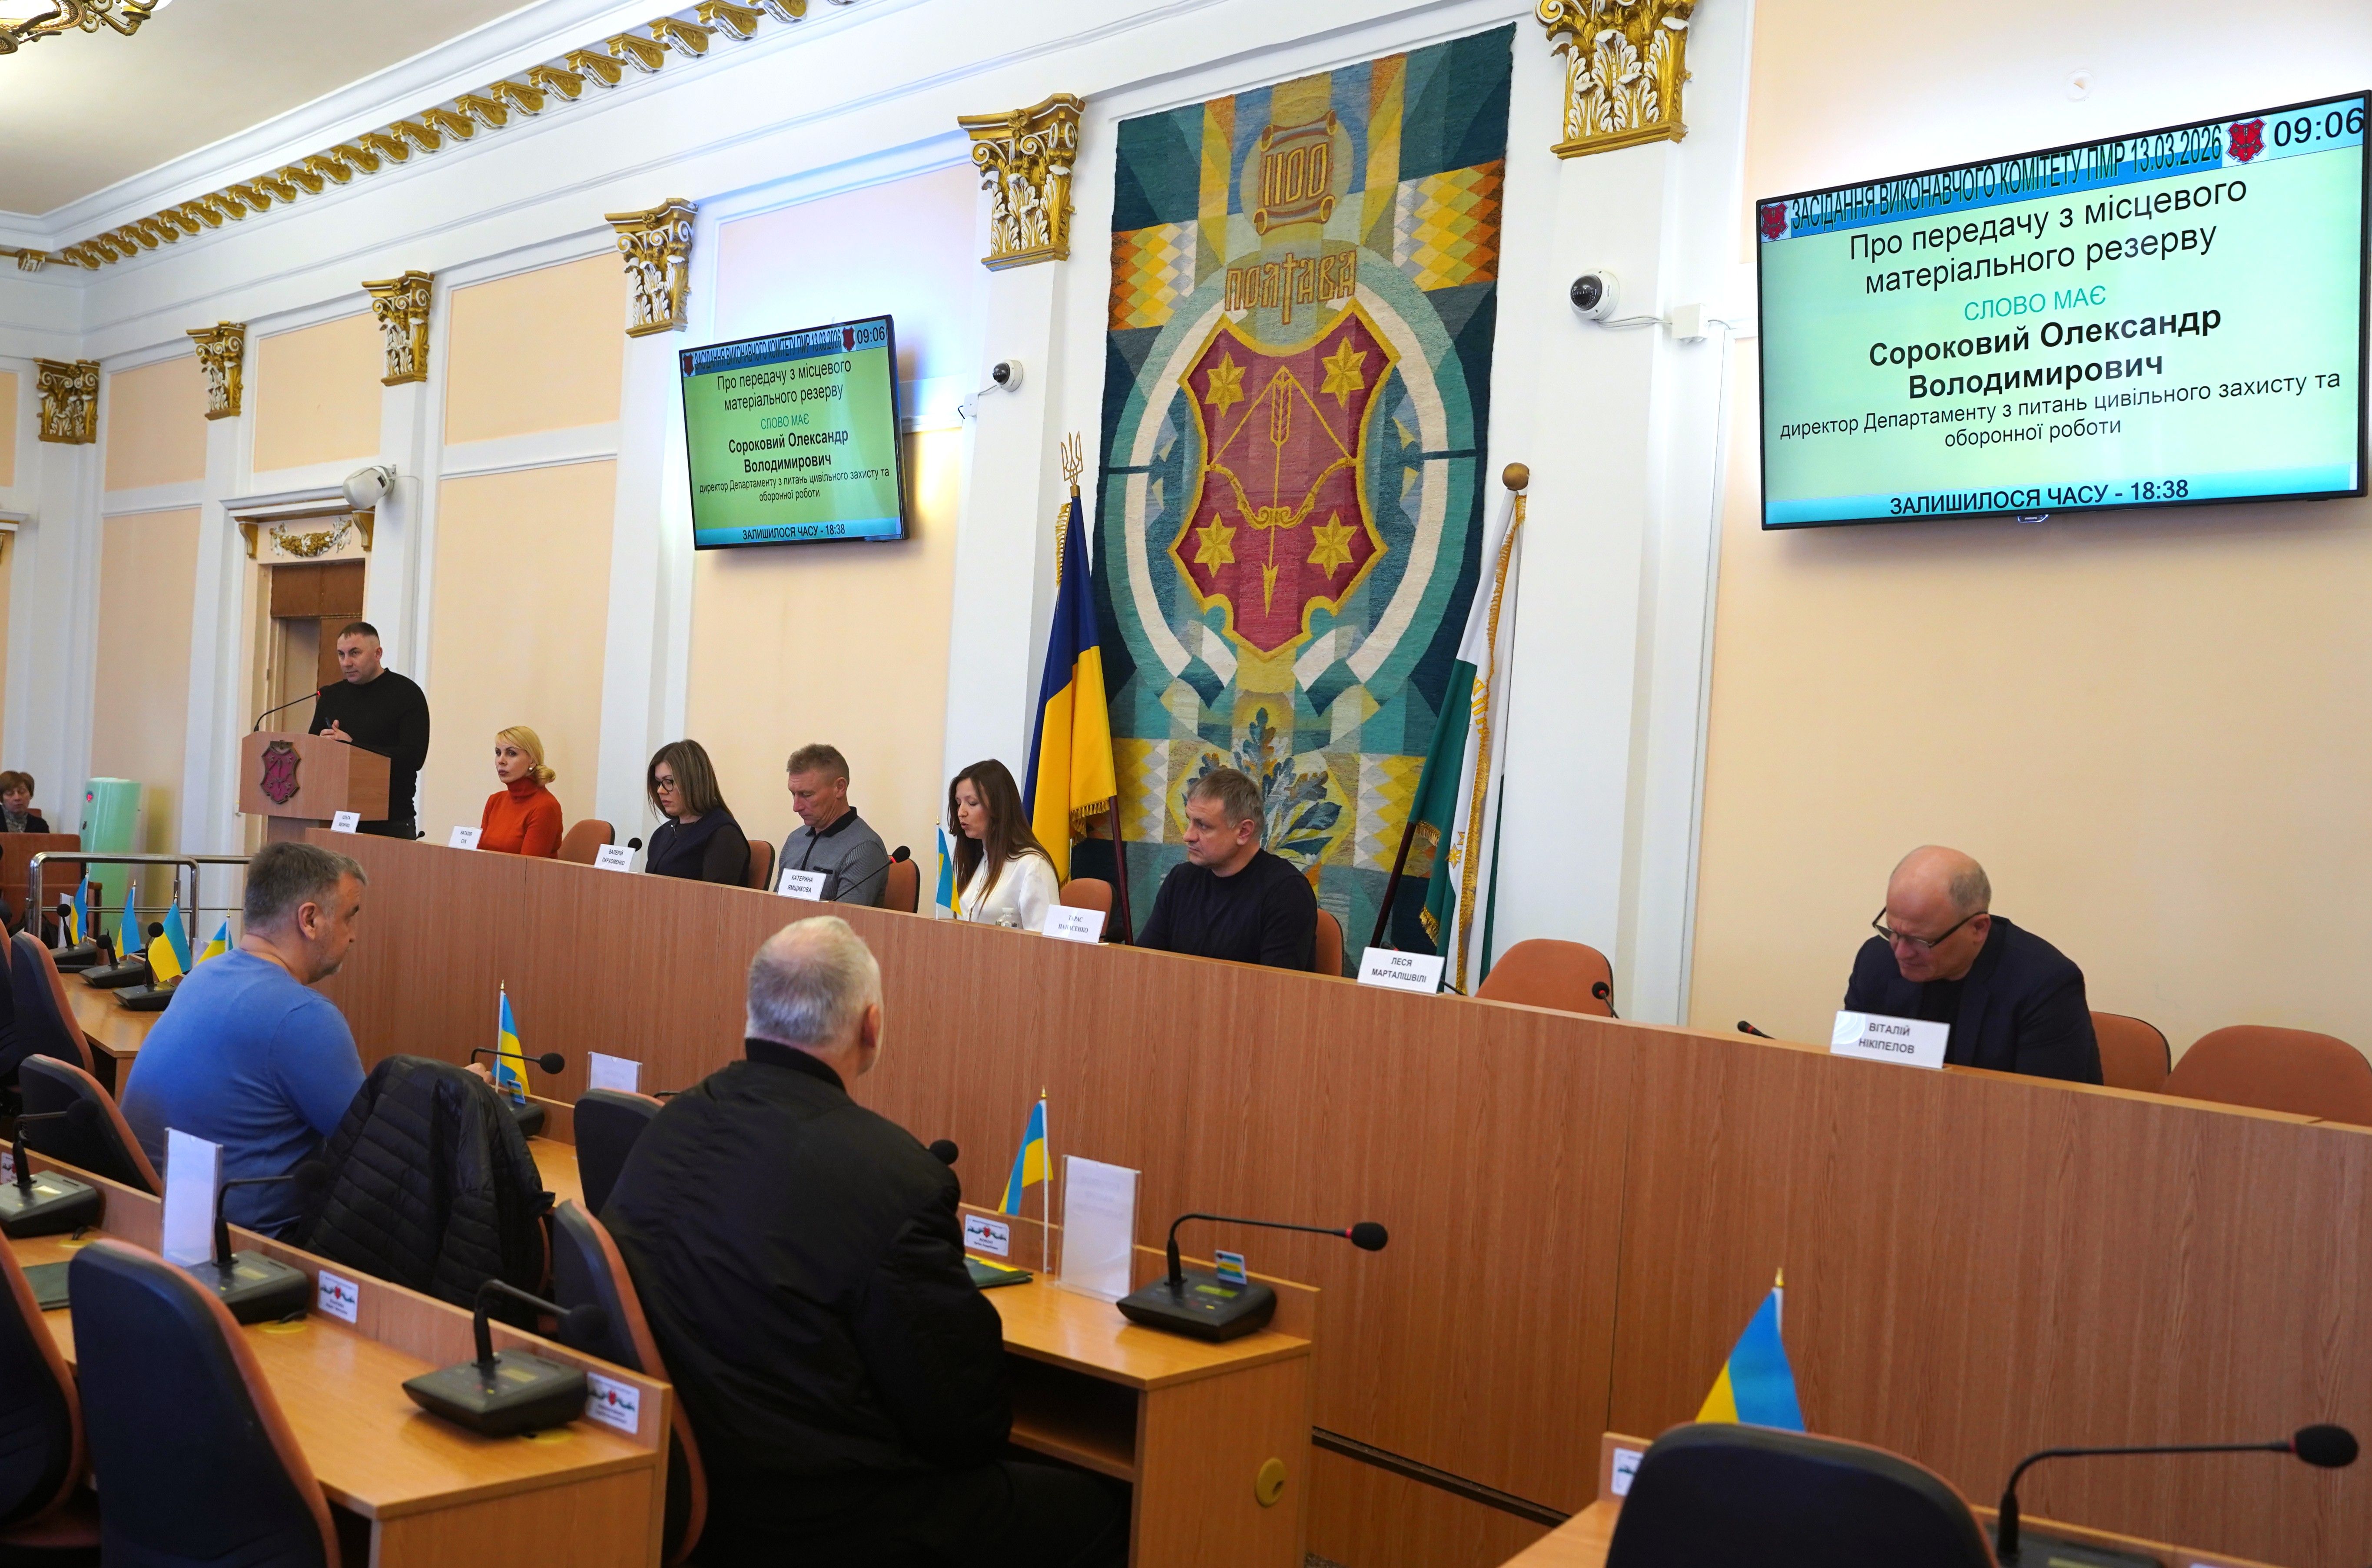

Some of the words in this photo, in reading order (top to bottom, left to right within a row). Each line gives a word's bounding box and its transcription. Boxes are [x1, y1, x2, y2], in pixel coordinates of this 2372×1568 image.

[2274, 107, 2364, 147] 09:06
[1792, 186, 1875, 231] ЗАСІДАННЯ
[1880, 165, 1996, 215] ВИКОНАВЧОГО
[2000, 150, 2082, 196] КОМІТЕТУ
[2087, 143, 2125, 182] ПМР
[2131, 125, 2222, 173] 13.03.2026
[1851, 233, 1902, 263] Про
[1913, 212, 2049, 251] передачу
[2060, 209, 2073, 228] з
[2086, 181, 2246, 224] місцевого
[1867, 247, 2075, 294] матеріального
[2087, 225, 2217, 270] резерву
[1224, 250, 1357, 325] ПОЛТАВА
[1964, 293, 2046, 321] СЛОВО
[2054, 286, 2106, 310] МАЄ
[857, 326, 885, 344] 09:06
[1870, 325, 2029, 368] Сороковий
[2041, 308, 2221, 347] Олександр
[695, 350, 725, 370] ЗАСІДАННЯ
[726, 341, 766, 365] ВИКОНАВЧОГО
[768, 337, 795, 359] КОМІТЕТУ
[797, 335, 810, 354] ПМР
[811, 329, 841, 351] 13.03.2026
[717, 375, 736, 393] Про
[740, 369, 786, 389] передачу
[790, 369, 795, 380] з
[799, 359, 851, 378] місцевого
[1910, 356, 2163, 398] Володимирович
[725, 390, 796, 411] матеріального
[801, 384, 843, 404] резерву
[1780, 417, 1858, 440] директор
[1864, 404, 1996, 432] Департаменту
[2002, 404, 2012, 417] з
[2019, 395, 2087, 415] питань
[2095, 385, 2210, 411] цивільного
[2219, 376, 2307, 398] захисту
[2315, 373, 2341, 389] та
[761, 416, 789, 430] СЛОВО
[792, 414, 809, 426] МАЄ
[1945, 424, 2043, 448] оборонної
[2050, 419, 2121, 443] роботи
[729, 434, 785, 455] Сороковий
[788, 428, 848, 448] Олександр
[744, 454, 831, 473] Володимирович
[700, 482, 728, 494] директор
[730, 477, 776, 492] Департаменту
[784, 476, 807, 485] питань
[809, 471, 848, 484] цивільного
[850, 470, 878, 480] захисту
[881, 468, 889, 477] та
[759, 490, 793, 503] оборонної
[796, 488, 820, 501] роботи
[1890, 489, 2040, 515] ЗАЛИШИЛОСЯ
[2048, 484, 2108, 505] ЧАСУ
[2131, 479, 2188, 501] 18:38
[743, 526, 796, 540] ЗАЛИШИЛОСЯ
[797, 525, 819, 536] ЧАСУ
[826, 523, 845, 534] 18:38
[602, 857, 625, 865] ПАРХОМЕНКО
[787, 885, 811, 893] ЯМЩИКОВА
[1372, 968, 1427, 983] МАРТАЛІШВІЛІ
[1391, 957, 1412, 967] ЛЕСЯ
[1869, 1022, 1911, 1036] ВІТАЛІЙ
[1859, 1038, 1914, 1054] НІКІПЕЛОВ
